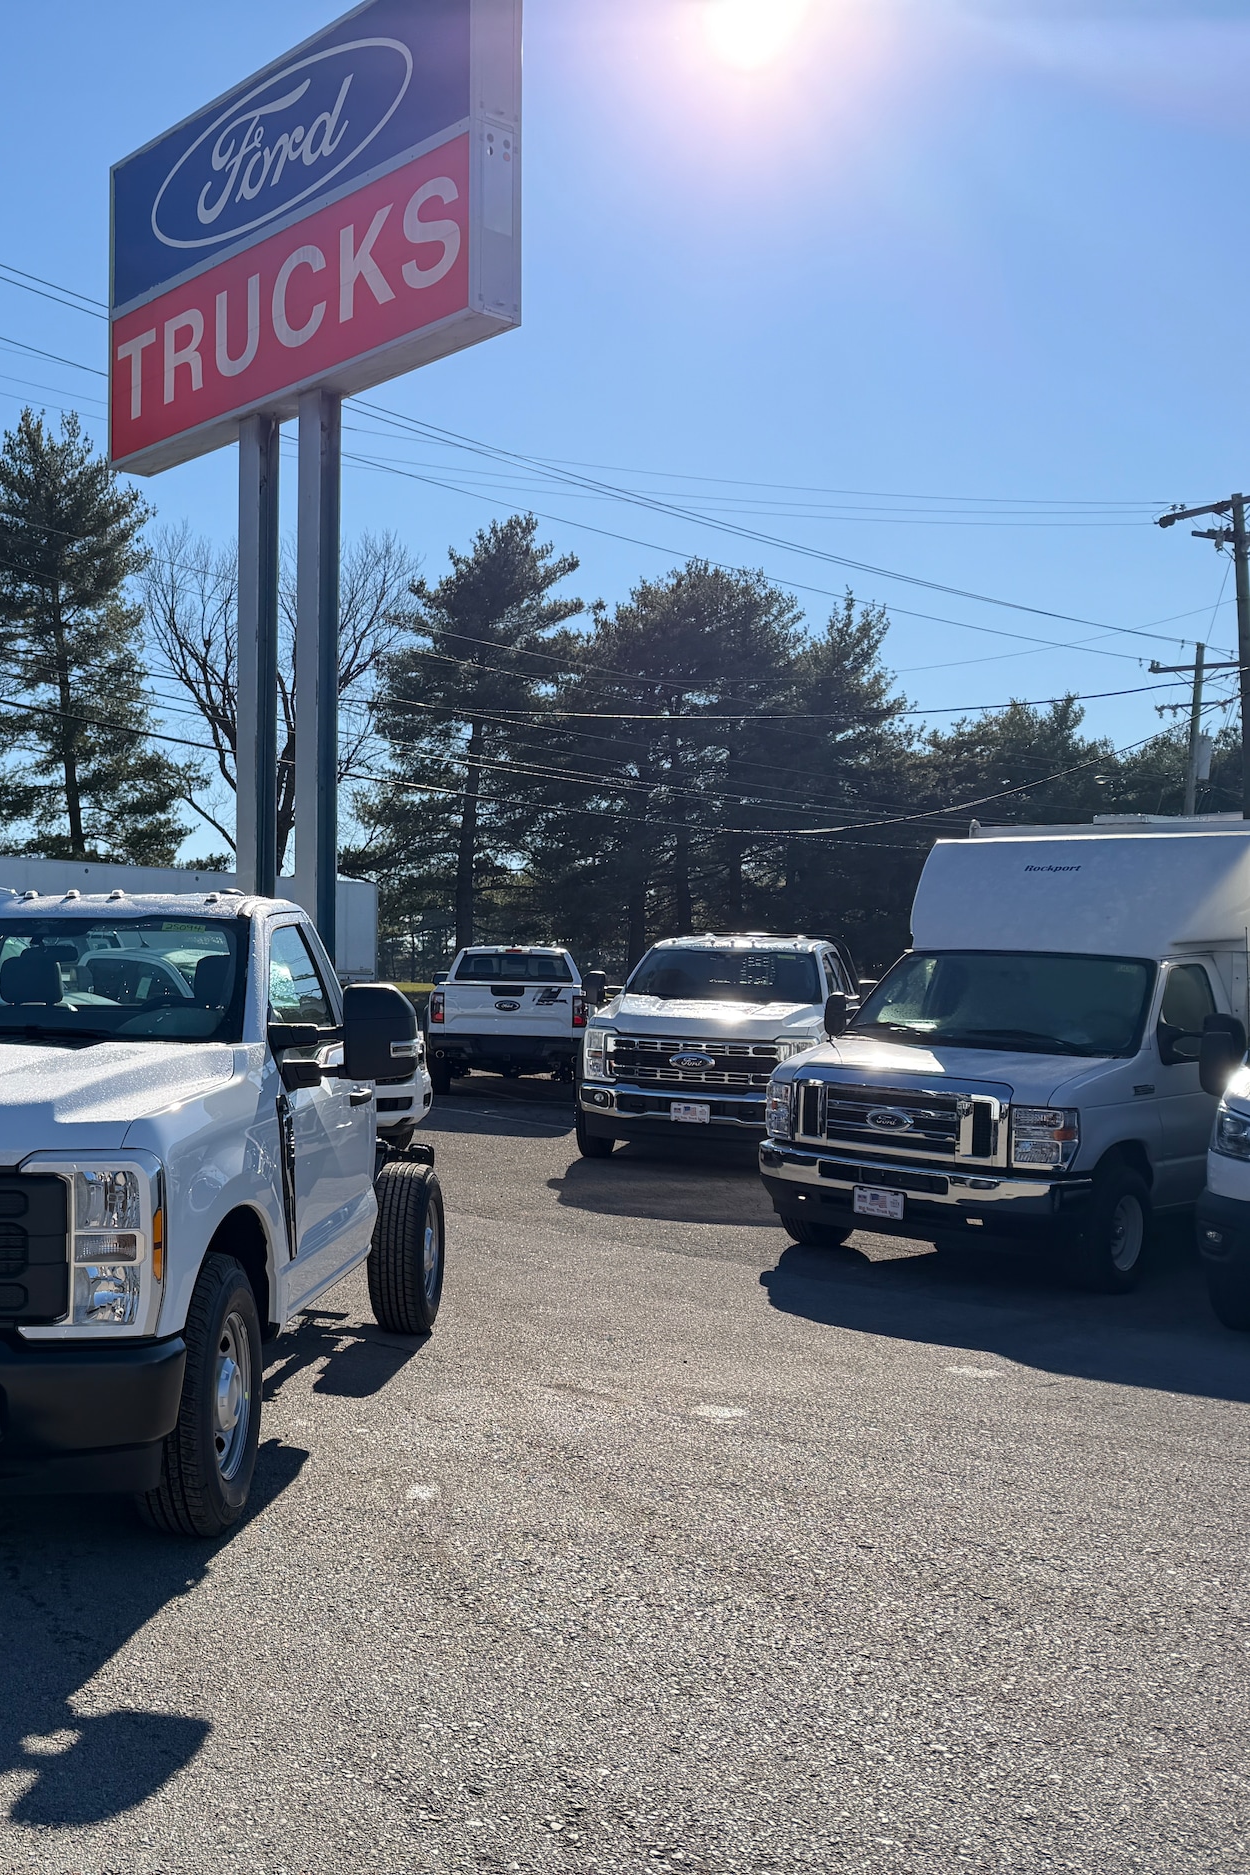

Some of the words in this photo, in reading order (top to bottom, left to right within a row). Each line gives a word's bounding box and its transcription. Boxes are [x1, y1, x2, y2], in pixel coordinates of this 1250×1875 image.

[196, 73, 354, 225] Ford
[117, 176, 461, 421] TRUCKS
[1024, 865, 1082, 873] Rockport
[680, 1057, 703, 1067] Ford
[876, 1115, 898, 1125] Ford
